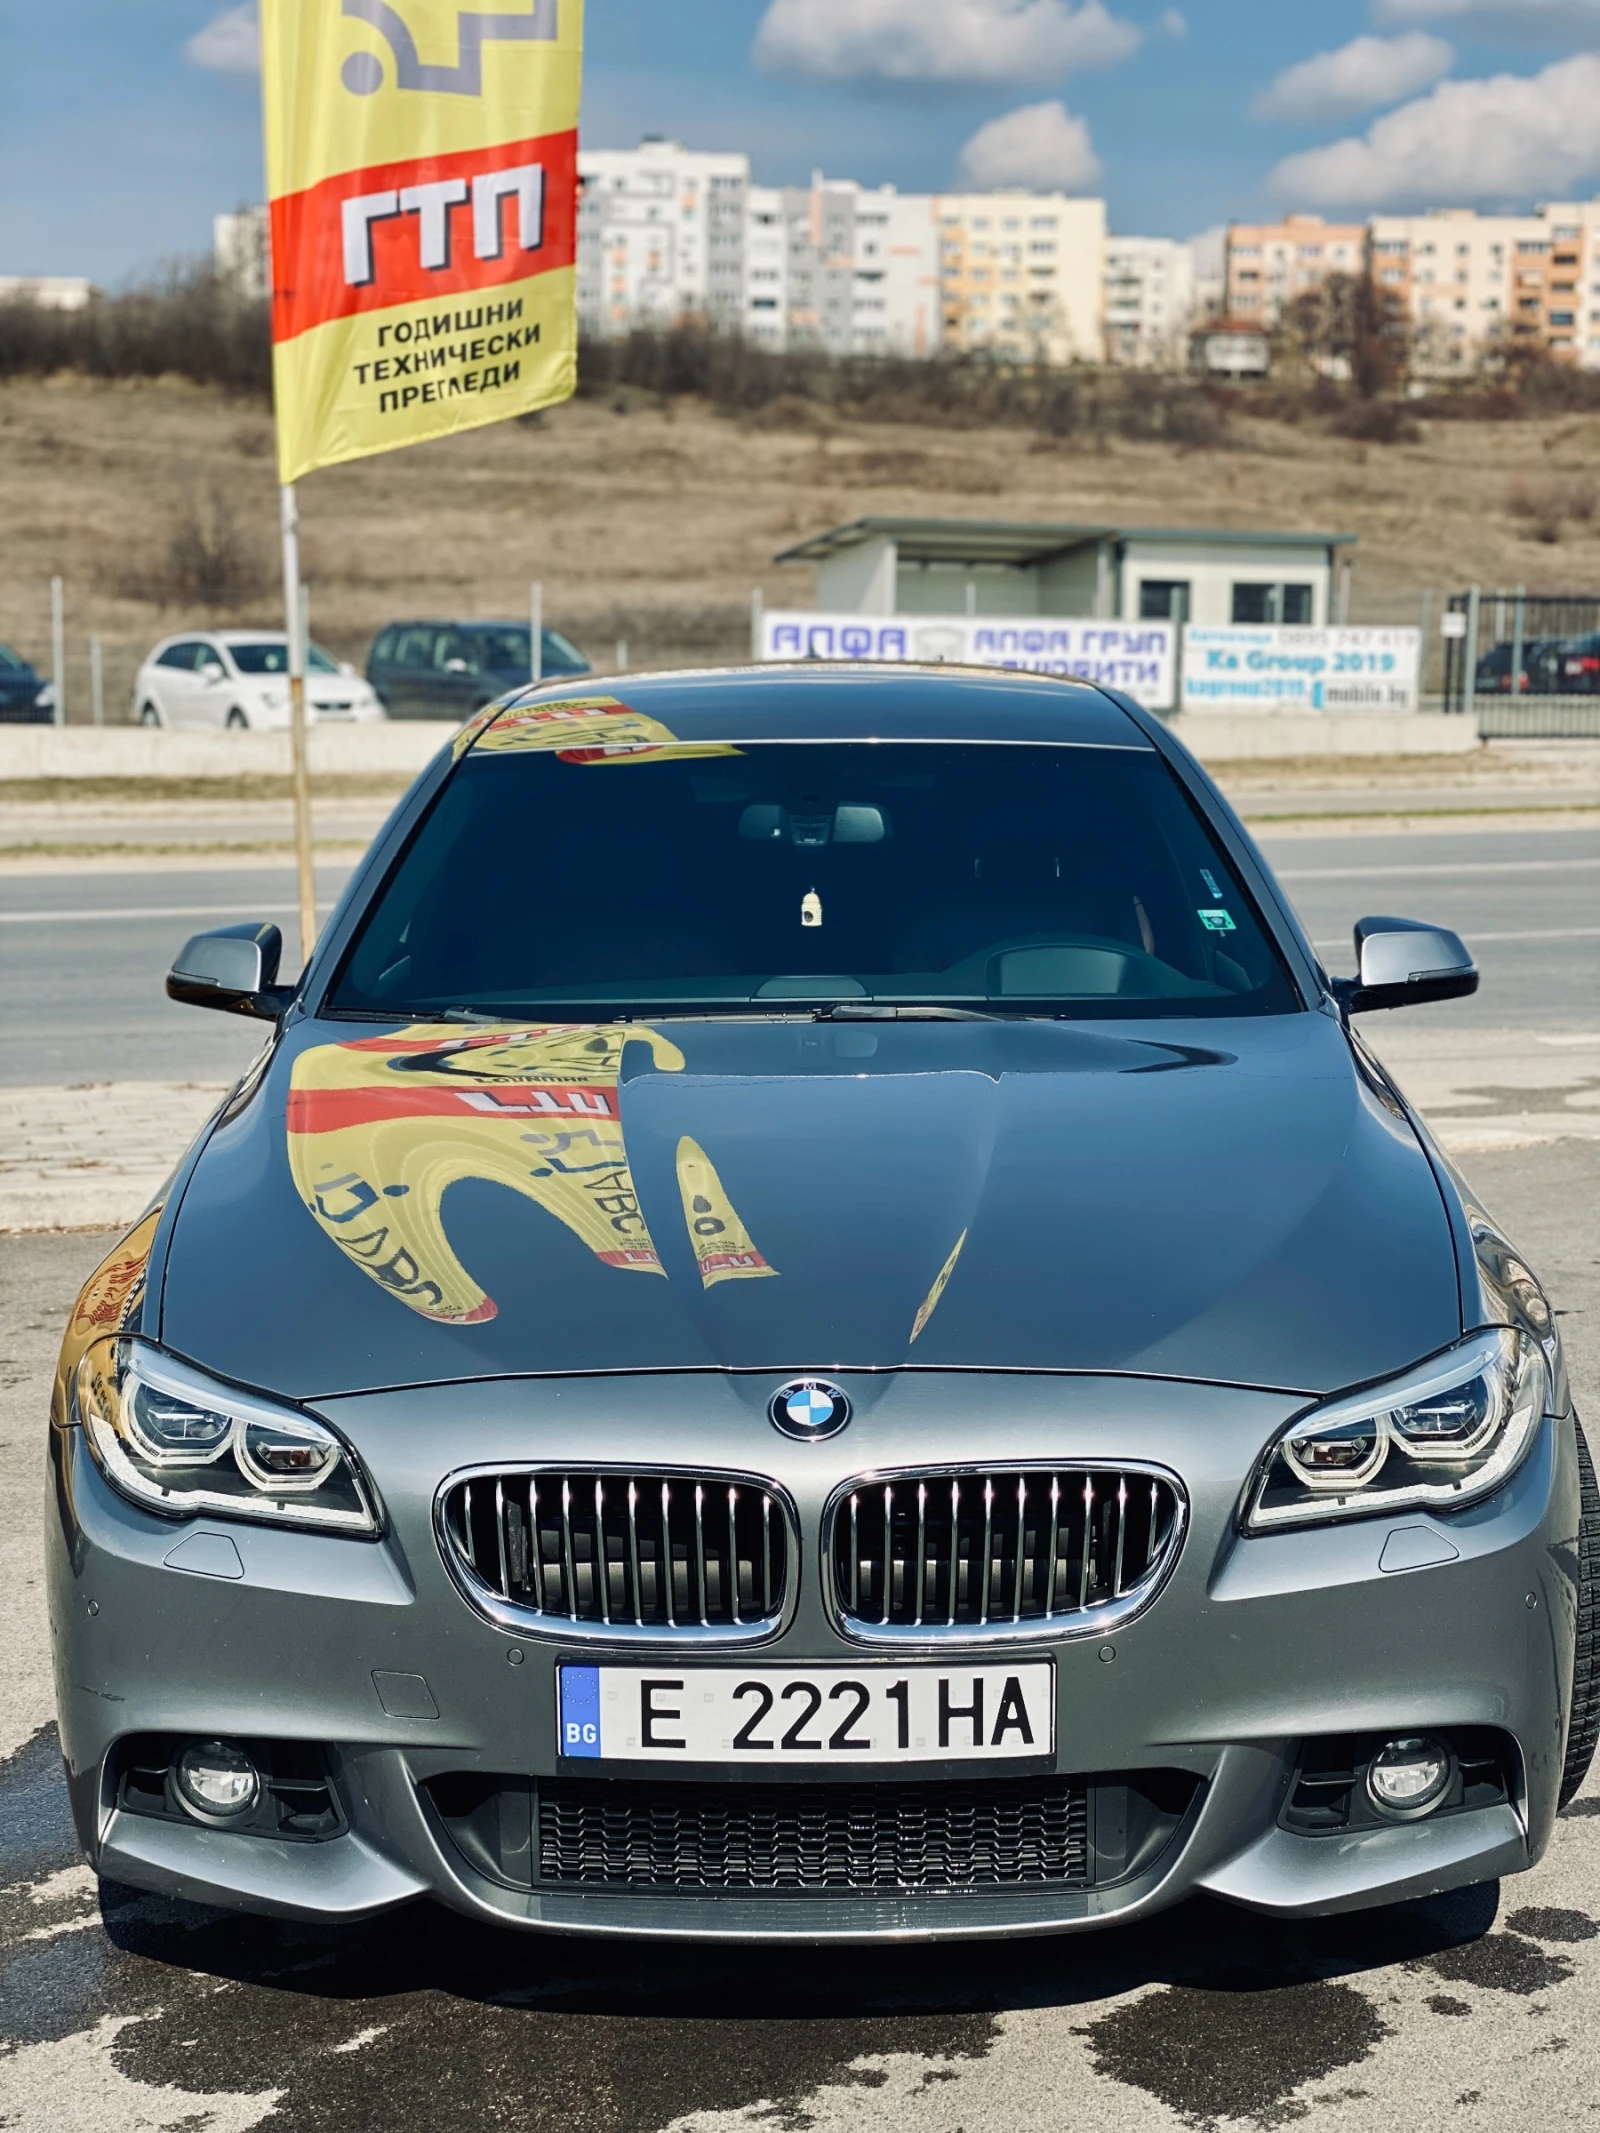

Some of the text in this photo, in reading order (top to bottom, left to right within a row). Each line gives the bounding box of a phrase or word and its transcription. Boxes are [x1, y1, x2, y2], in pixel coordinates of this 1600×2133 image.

[342, 163, 546, 288] ГТП
[377, 299, 524, 347] ГОДИШНИ
[353, 323, 542, 385] ТЕХНИЧЕСКИ
[379, 361, 521, 413] ПРЕГЛЕДИ
[1083, 630, 1167, 654] ГРУП
[1247, 651, 1326, 673] Group
[1334, 652, 1395, 671] 2019
[780, 1382, 842, 1400] BMW
[566, 1722, 597, 1744] BG
[640, 1676, 1035, 1750] E 2221 HA
